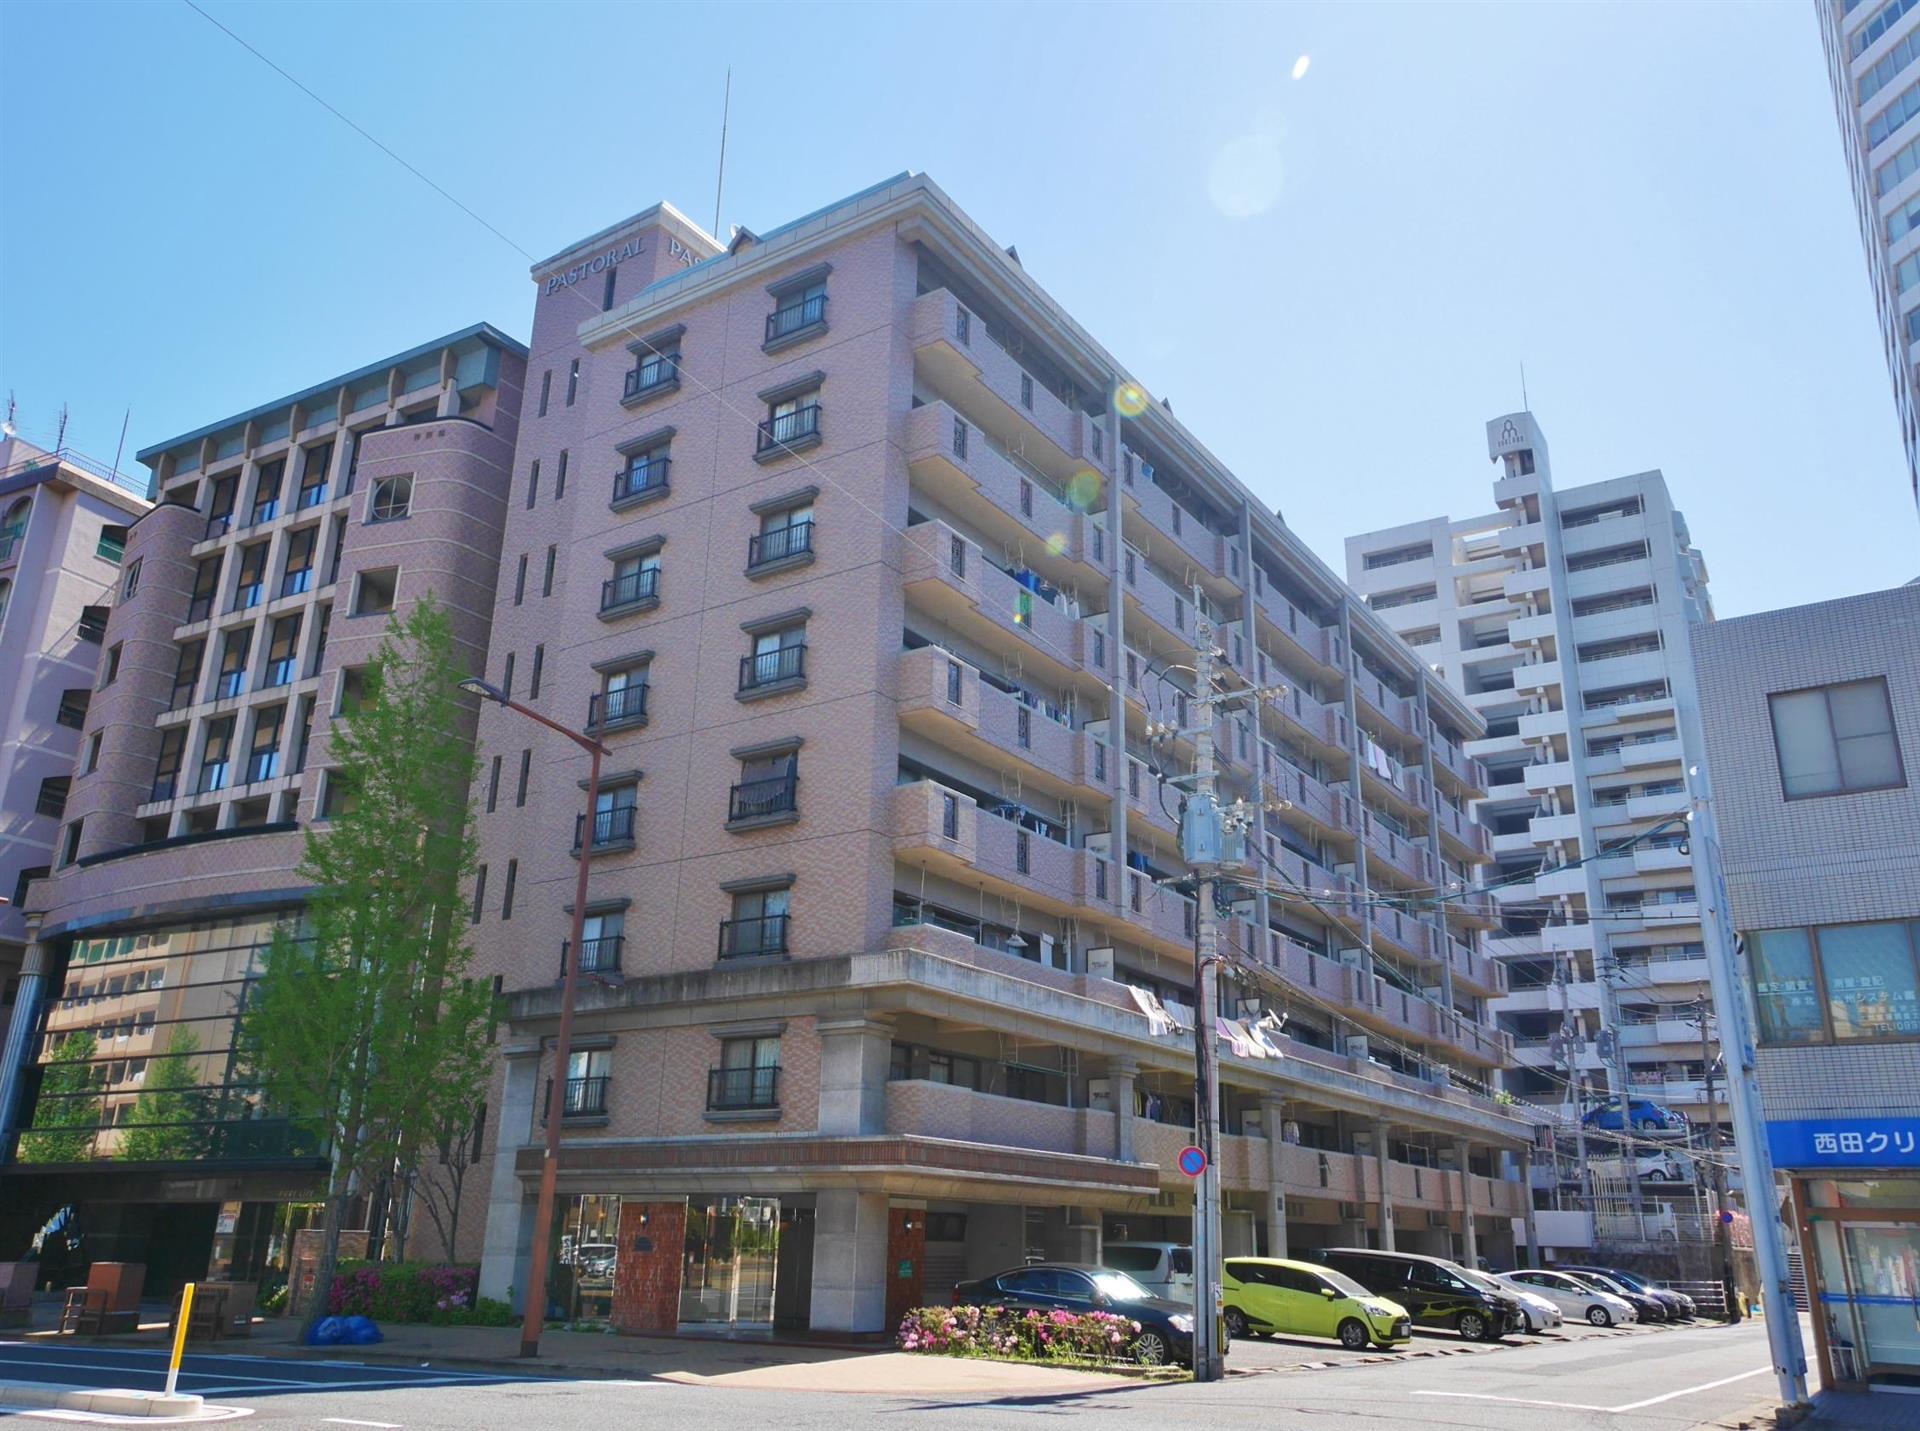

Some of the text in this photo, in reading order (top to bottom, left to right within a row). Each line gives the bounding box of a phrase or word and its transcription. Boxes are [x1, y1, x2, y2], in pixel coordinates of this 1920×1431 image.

[545, 237, 647, 296] PASTORAL
[1813, 1131, 1915, 1153] 西田クリ
